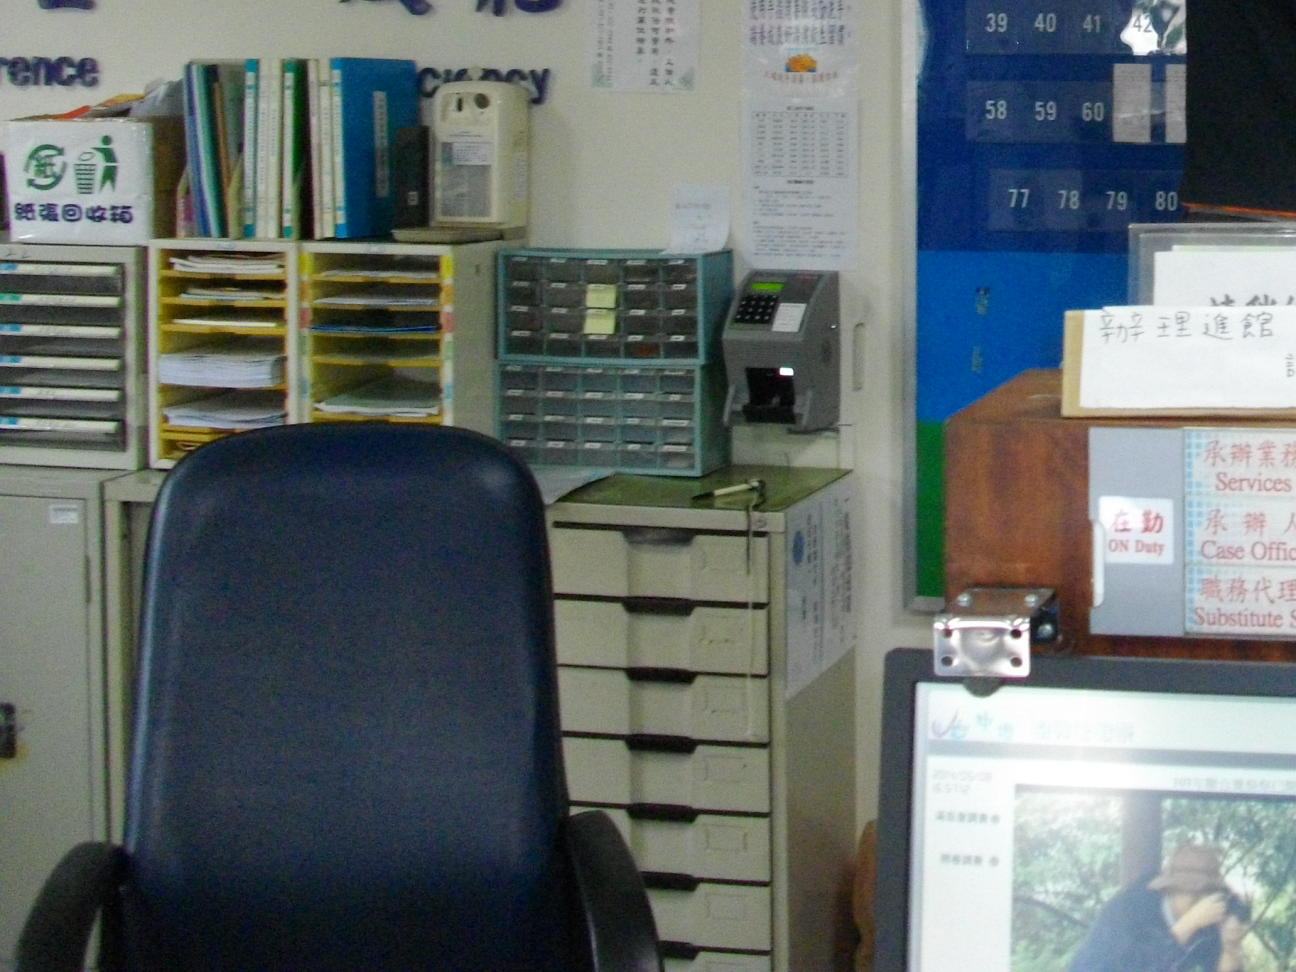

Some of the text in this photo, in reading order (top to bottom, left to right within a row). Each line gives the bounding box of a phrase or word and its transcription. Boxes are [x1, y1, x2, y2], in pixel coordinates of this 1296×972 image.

[984, 11, 1009, 34] 39
[1032, 11, 1058, 34] 40
[1081, 13, 1102, 34] 41
[1132, 12, 1154, 35] 42
[984, 98, 1009, 121] 58
[1033, 99, 1058, 123] 59
[1080, 100, 1106, 123] 60
[1006, 187, 1031, 209] 77
[1057, 188, 1081, 211] 78
[1105, 189, 1129, 213] 79
[1153, 189, 1179, 213] 80
[1215, 471, 1293, 493] Services
[1108, 539, 1165, 557] ON Duty
[1200, 540, 1245, 561] Case
[1193, 606, 1284, 628] Substitute
